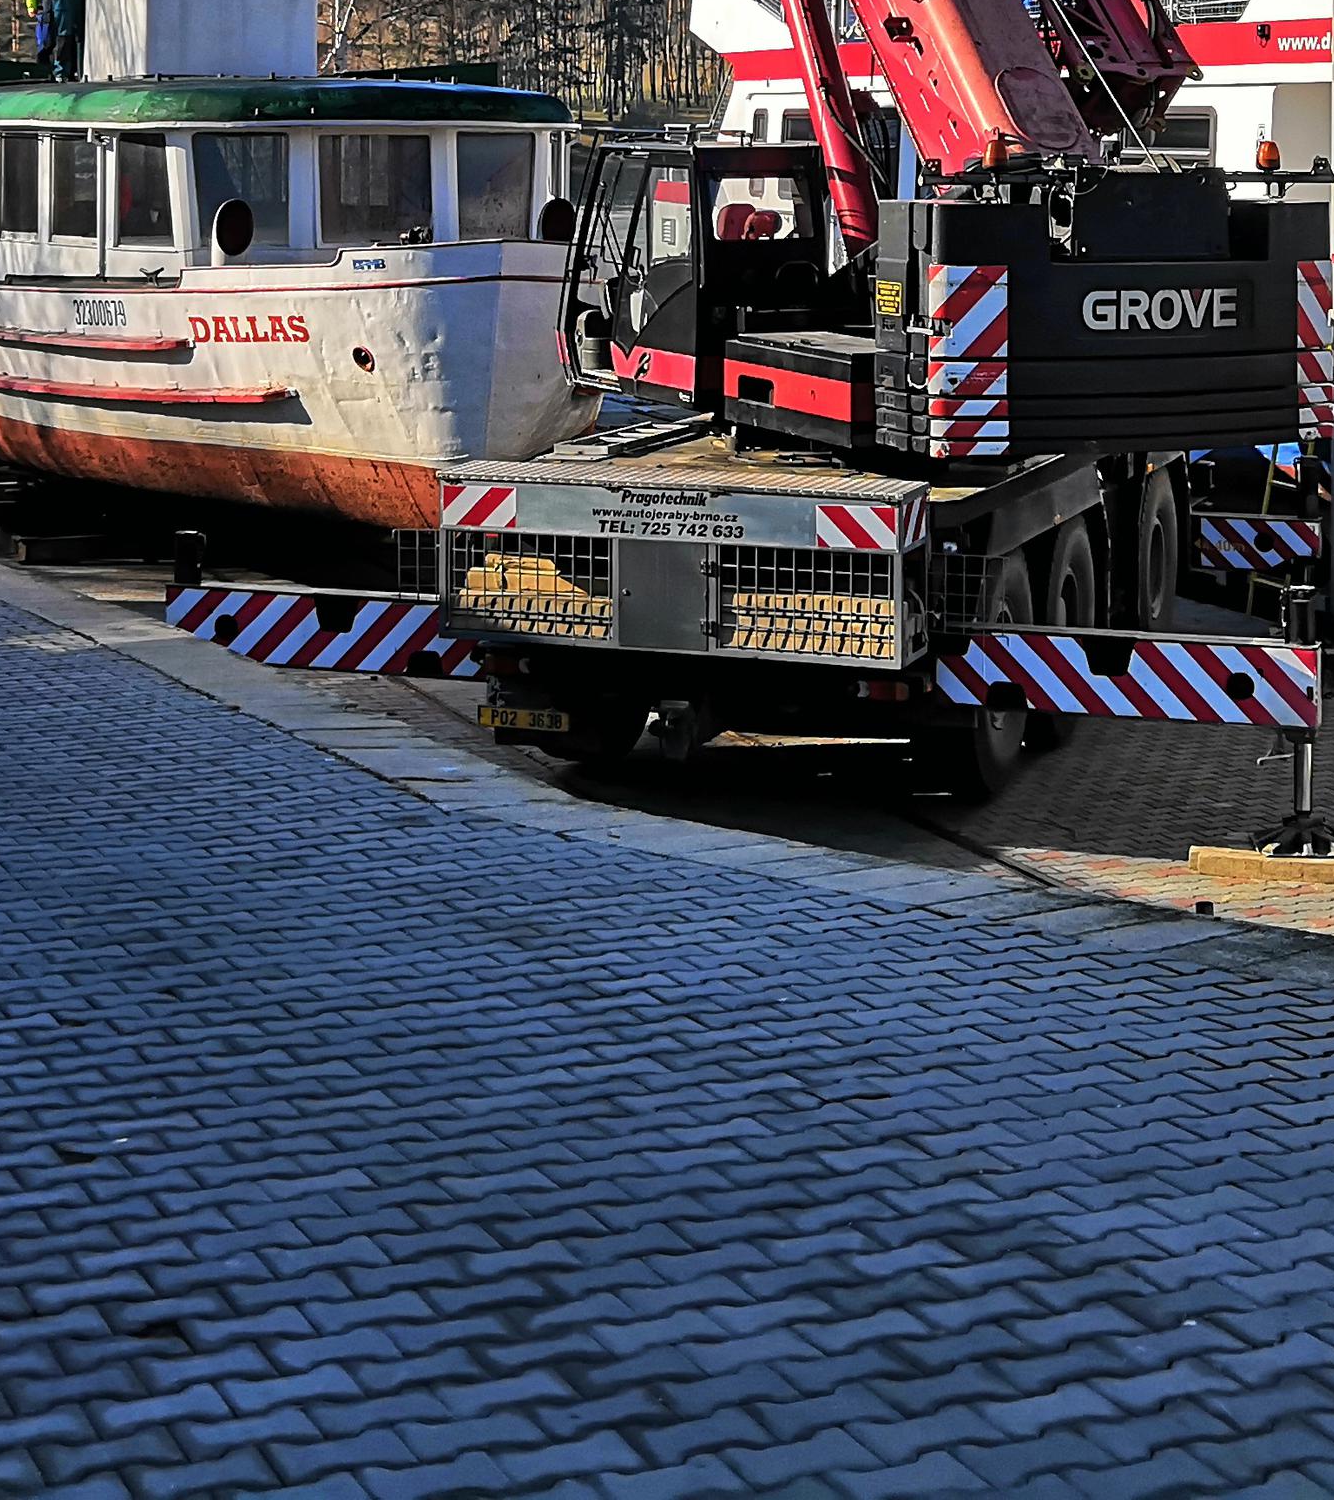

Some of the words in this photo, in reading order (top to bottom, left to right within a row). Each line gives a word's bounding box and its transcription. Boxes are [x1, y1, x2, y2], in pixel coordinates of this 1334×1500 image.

[73, 299, 126, 326] 32300679
[1082, 288, 1238, 330] GROVE
[188, 315, 310, 343] DALLAS
[620, 489, 708, 507] Pragotechnik
[598, 519, 635, 534] TEL:
[641, 521, 671, 536] 725
[677, 523, 708, 537] 742
[712, 525, 744, 539] 633
